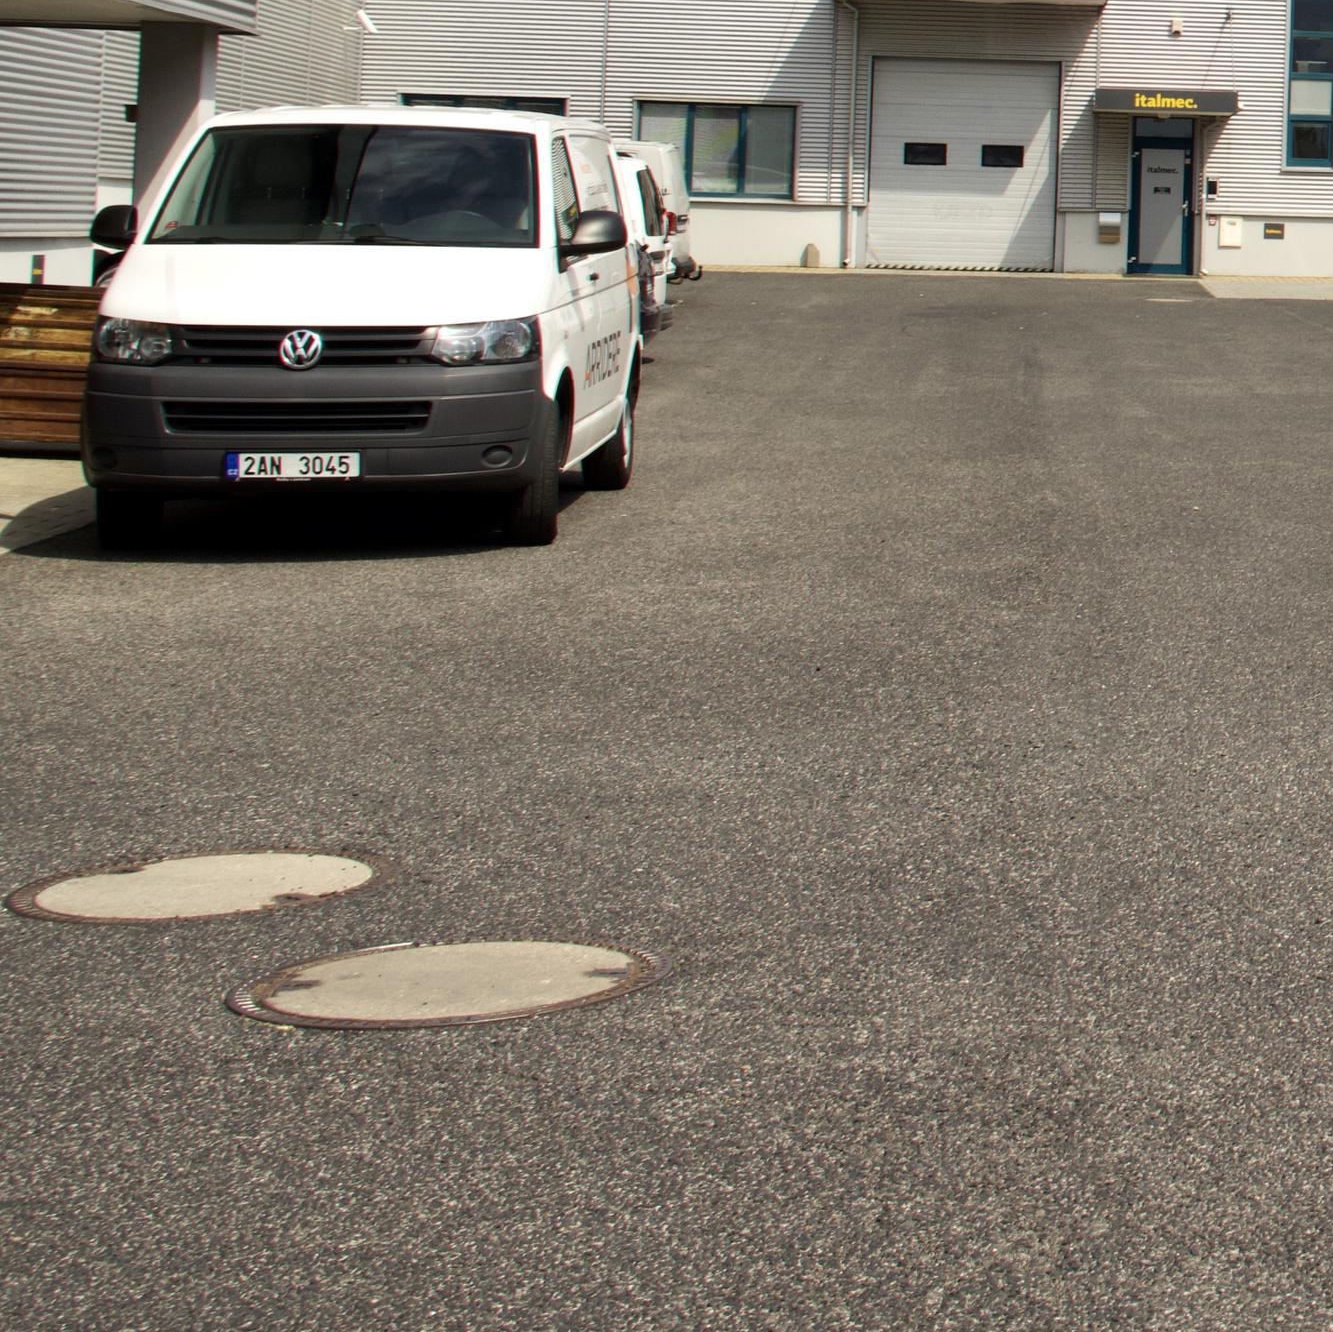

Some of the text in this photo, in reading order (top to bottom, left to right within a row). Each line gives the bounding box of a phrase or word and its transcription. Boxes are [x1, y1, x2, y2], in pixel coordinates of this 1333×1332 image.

[1134, 93, 1198, 109] italmec.
[244, 456, 282, 476] 2AN
[299, 456, 350, 476] 3045
